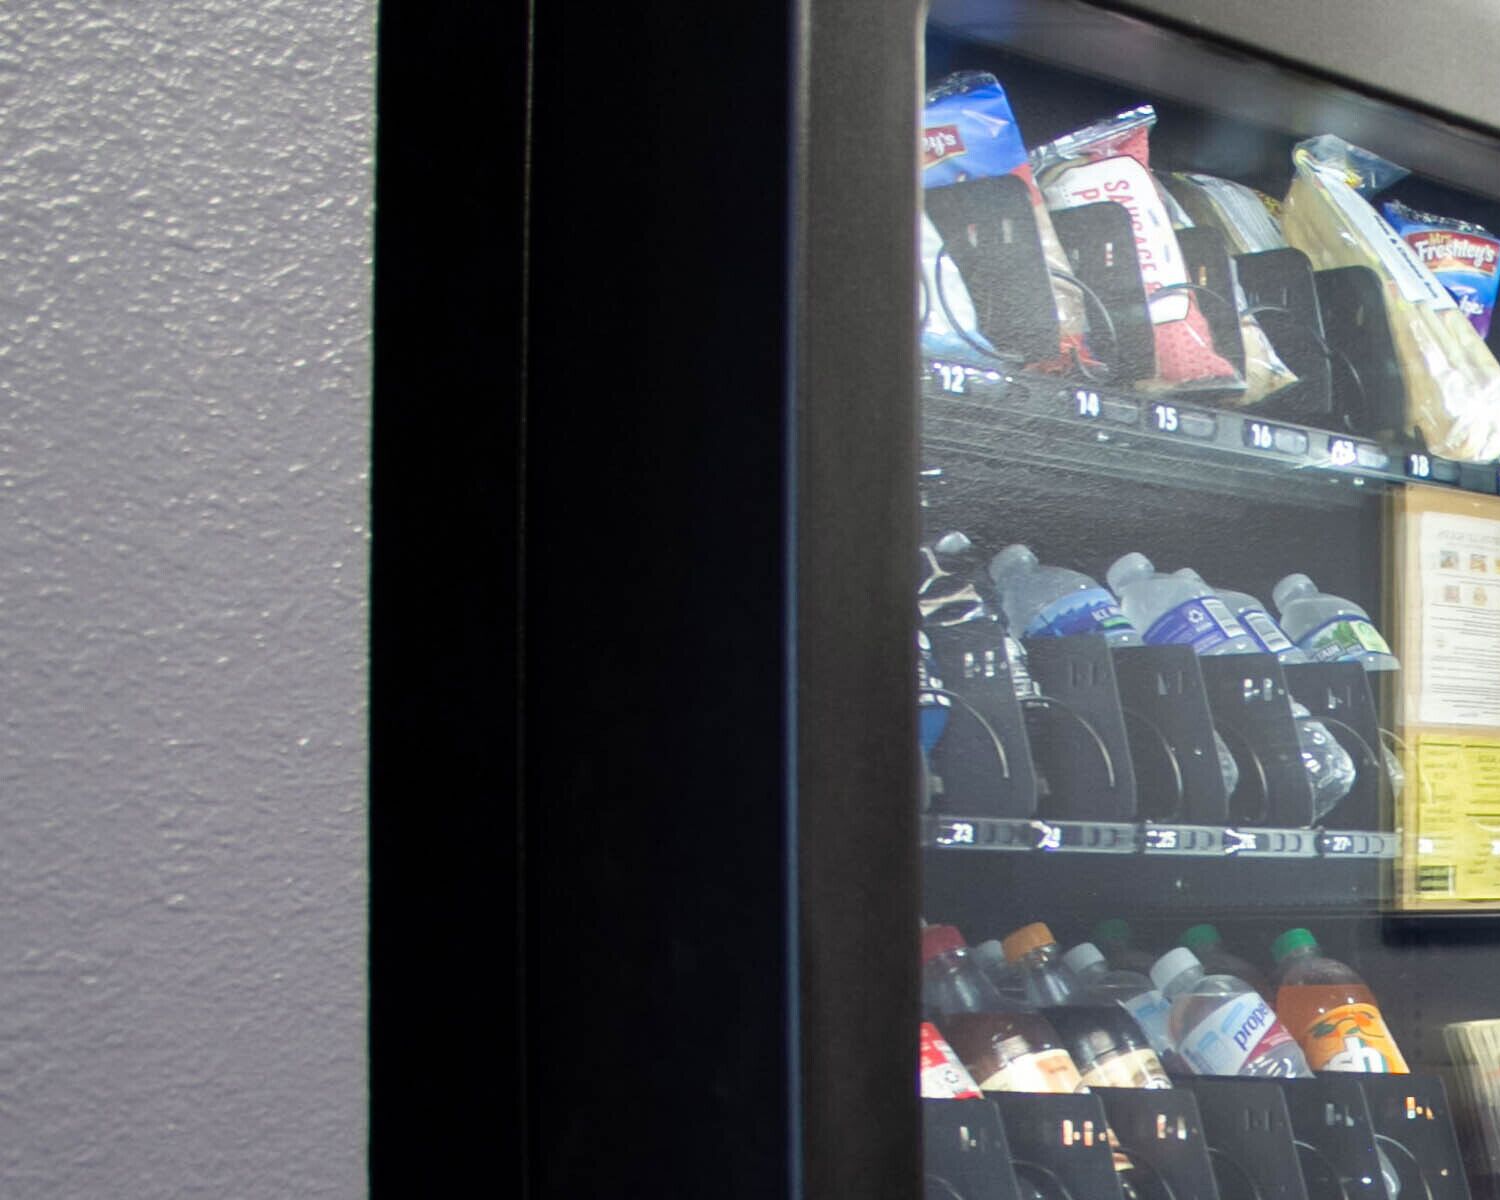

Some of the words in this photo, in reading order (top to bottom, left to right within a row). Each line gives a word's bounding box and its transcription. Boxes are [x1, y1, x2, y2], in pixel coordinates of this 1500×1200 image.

[1415, 239, 1496, 267] Freshley's
[939, 365, 964, 393] 12
[1076, 391, 1099, 416] 14
[1156, 405, 1178, 431] 15
[1252, 424, 1272, 448] 16
[1411, 455, 1430, 477] 18
